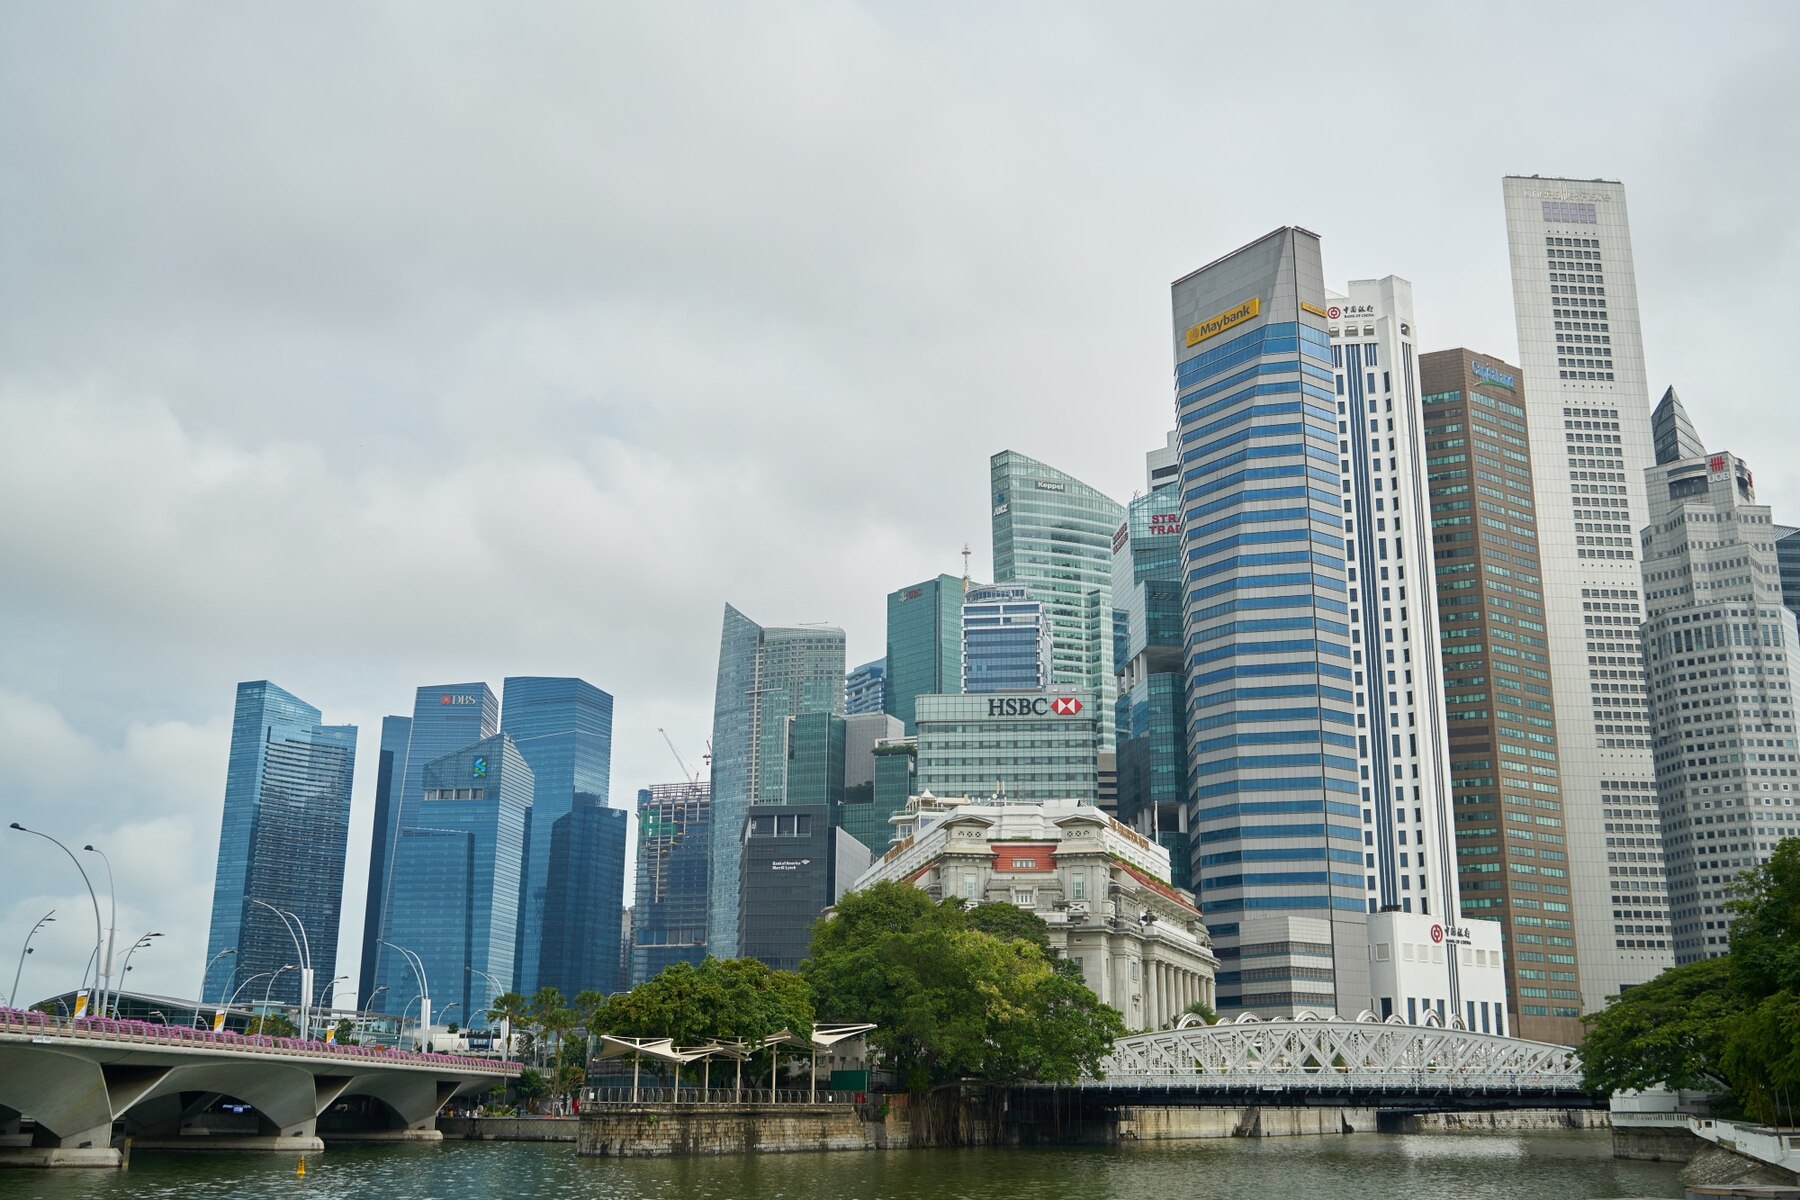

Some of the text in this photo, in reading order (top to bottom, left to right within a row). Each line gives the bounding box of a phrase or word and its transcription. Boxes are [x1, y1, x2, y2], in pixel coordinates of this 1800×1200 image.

[1200, 305, 1250, 336] Maybank
[1707, 471, 1730, 483] UOB
[1037, 481, 1064, 491] Keppel
[993, 504, 1009, 516] ANZ
[452, 695, 476, 704] DBS
[988, 698, 1048, 716] HSBC
